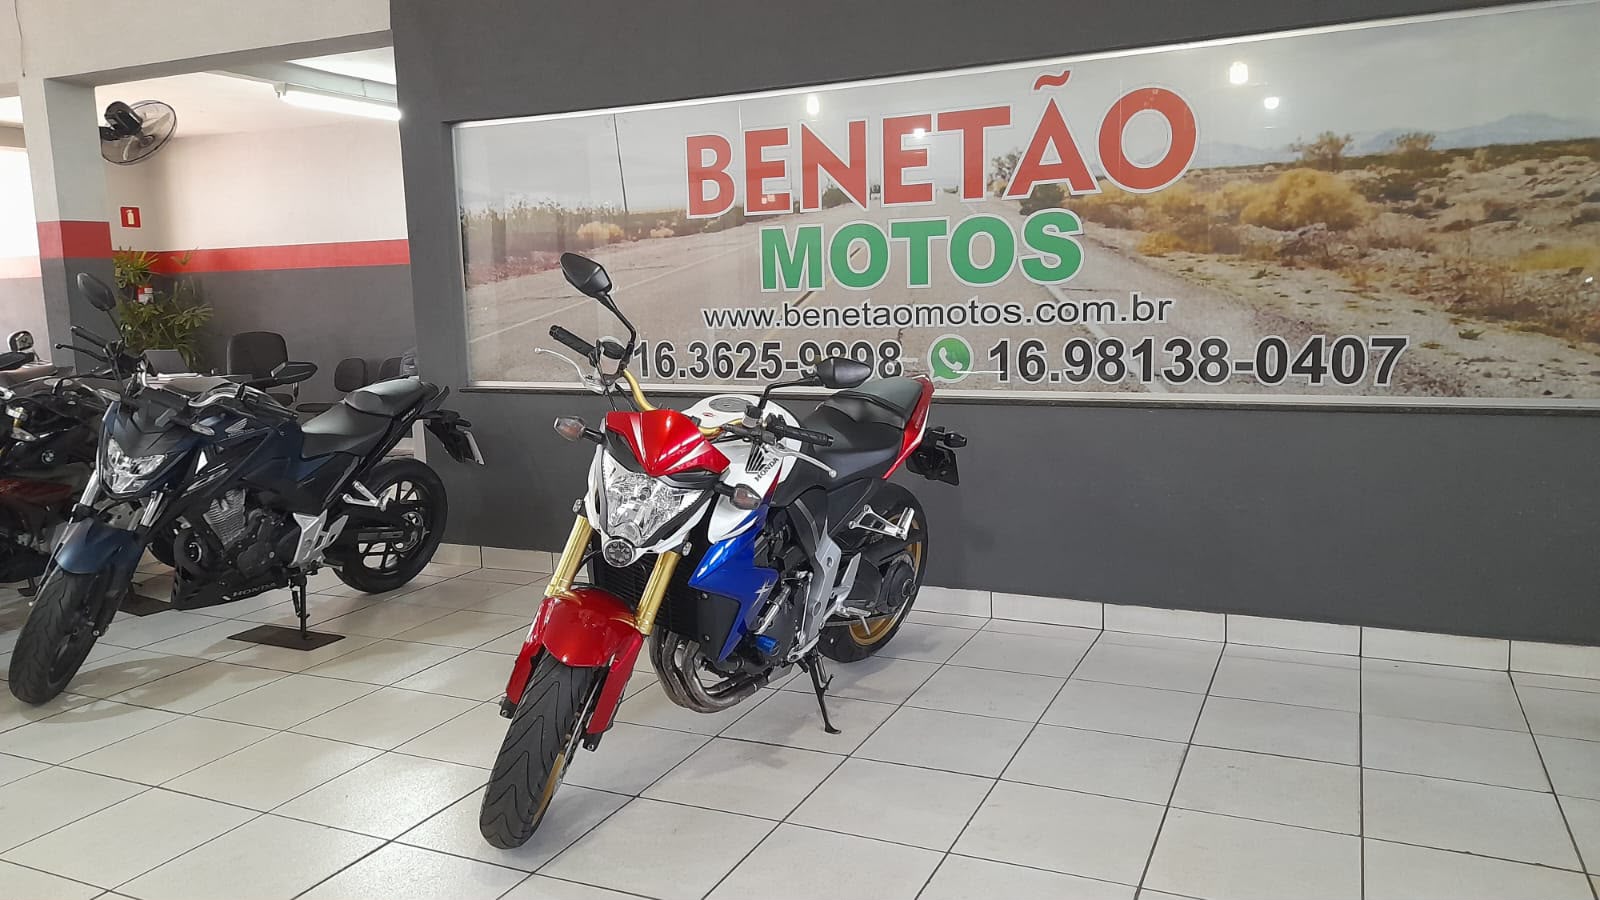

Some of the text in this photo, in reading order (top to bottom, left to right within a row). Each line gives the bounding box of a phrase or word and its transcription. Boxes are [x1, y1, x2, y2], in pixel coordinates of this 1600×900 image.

[686, 70, 1197, 217] BENETÃO
[761, 212, 1084, 291] MOTOS
[703, 295, 1173, 328] www.benetaomotos.com.br
[988, 336, 1408, 385] 16.98138-0407
[754, 457, 780, 482] HONDA
